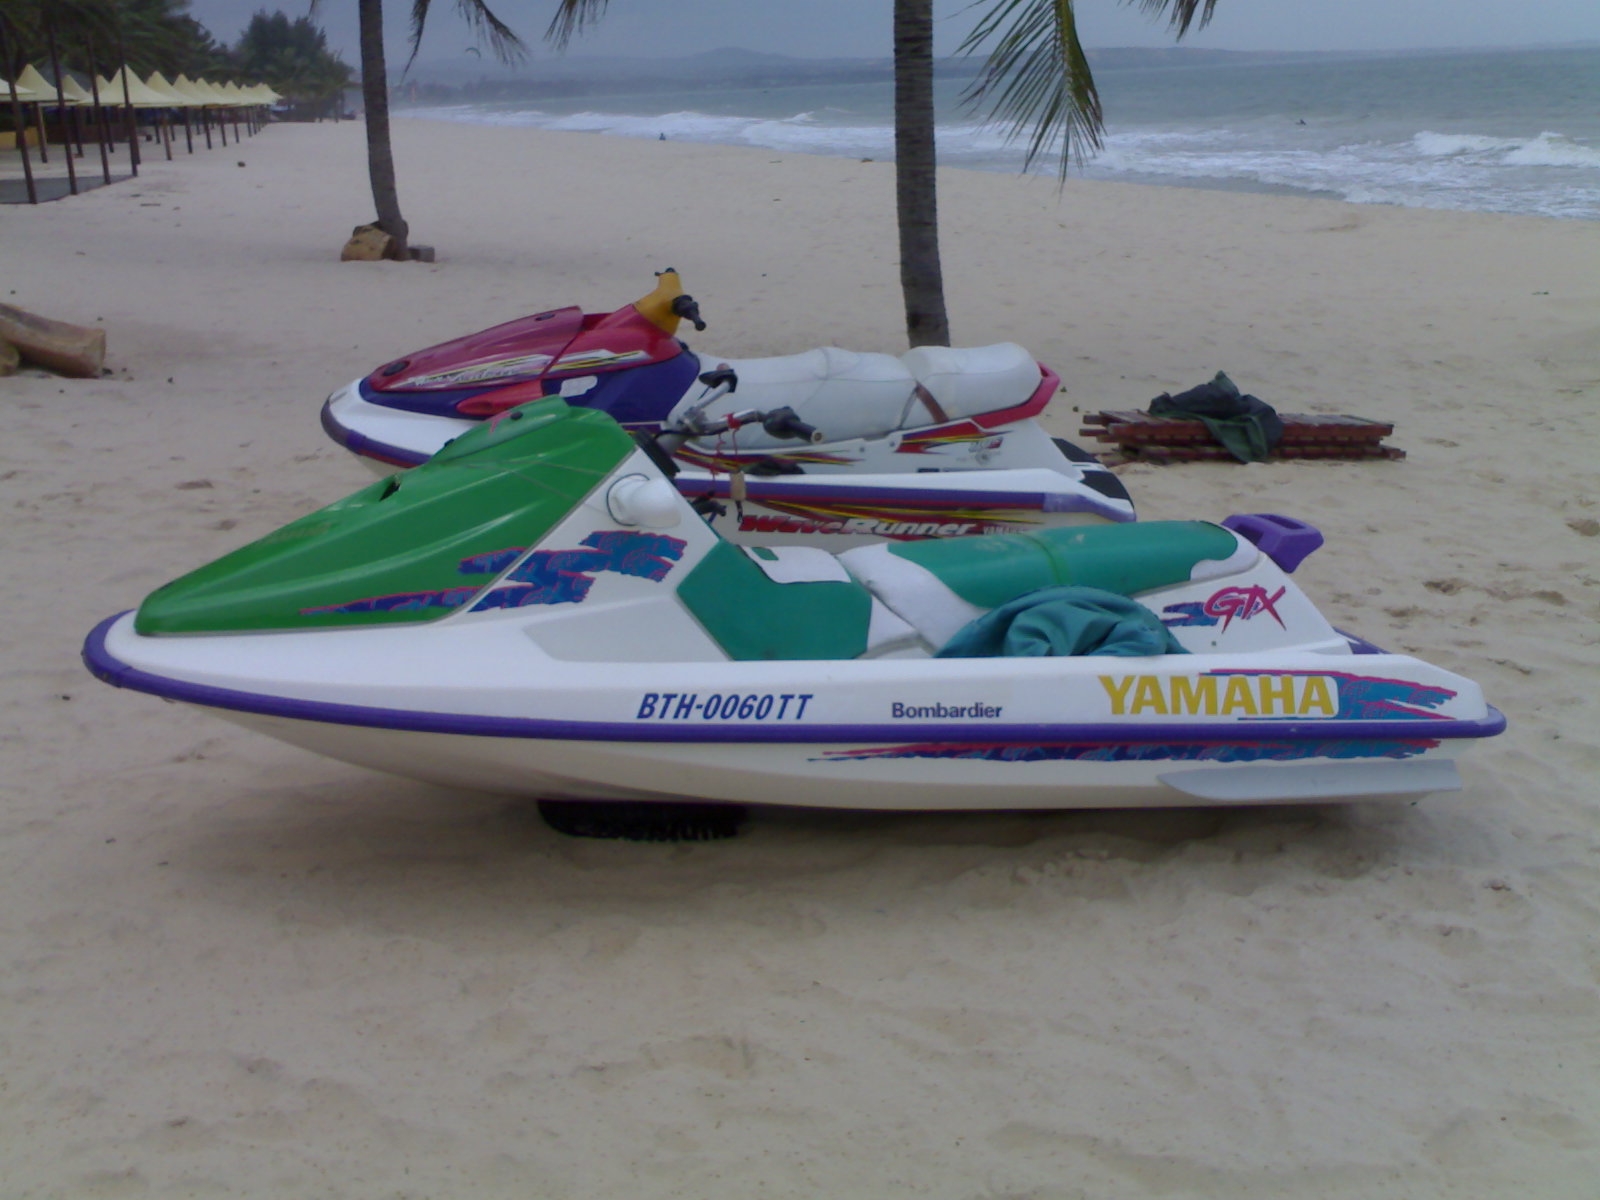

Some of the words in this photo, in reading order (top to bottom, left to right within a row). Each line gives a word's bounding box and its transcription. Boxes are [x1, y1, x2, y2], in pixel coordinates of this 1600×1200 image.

[1203, 584, 1287, 634] GTX
[637, 693, 813, 720] BTH-0060TT
[891, 702, 1002, 718] Bombardier
[1098, 675, 1335, 715] YAMAHA
